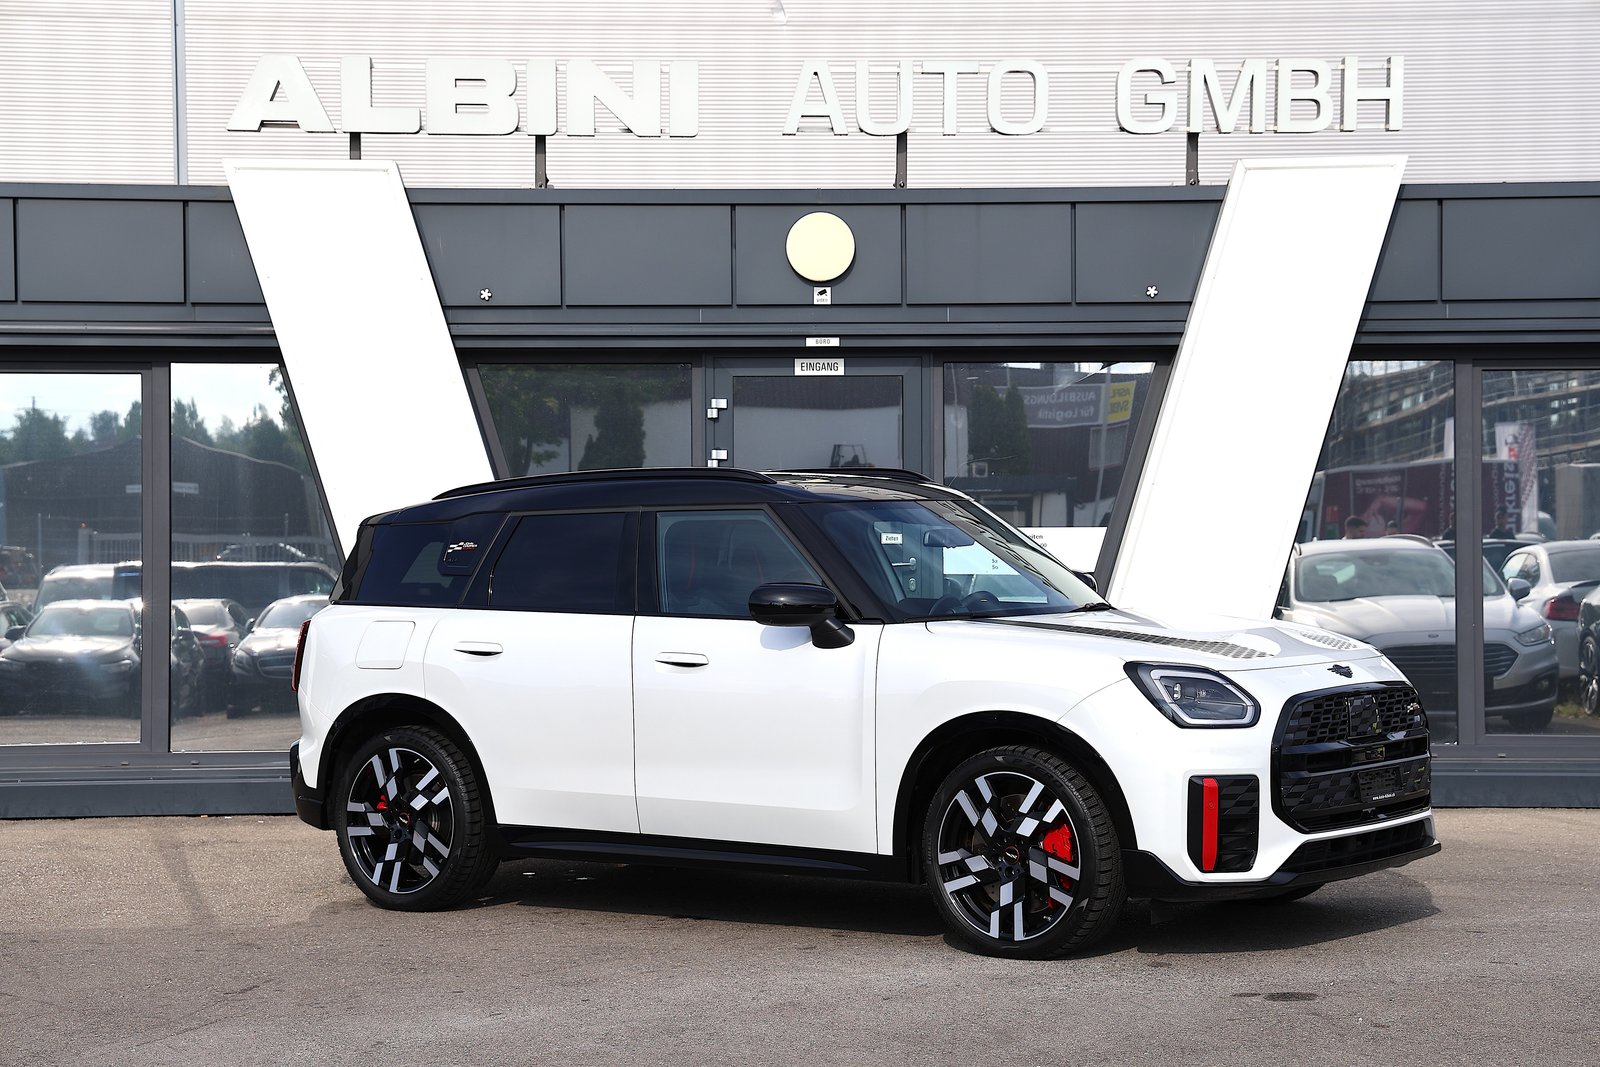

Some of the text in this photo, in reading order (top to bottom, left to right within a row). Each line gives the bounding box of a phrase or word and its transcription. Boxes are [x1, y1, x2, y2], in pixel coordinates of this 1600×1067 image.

[226, 54, 1405, 137] ALBINI AUTO GMBH
[800, 362, 839, 372] EINGANG
